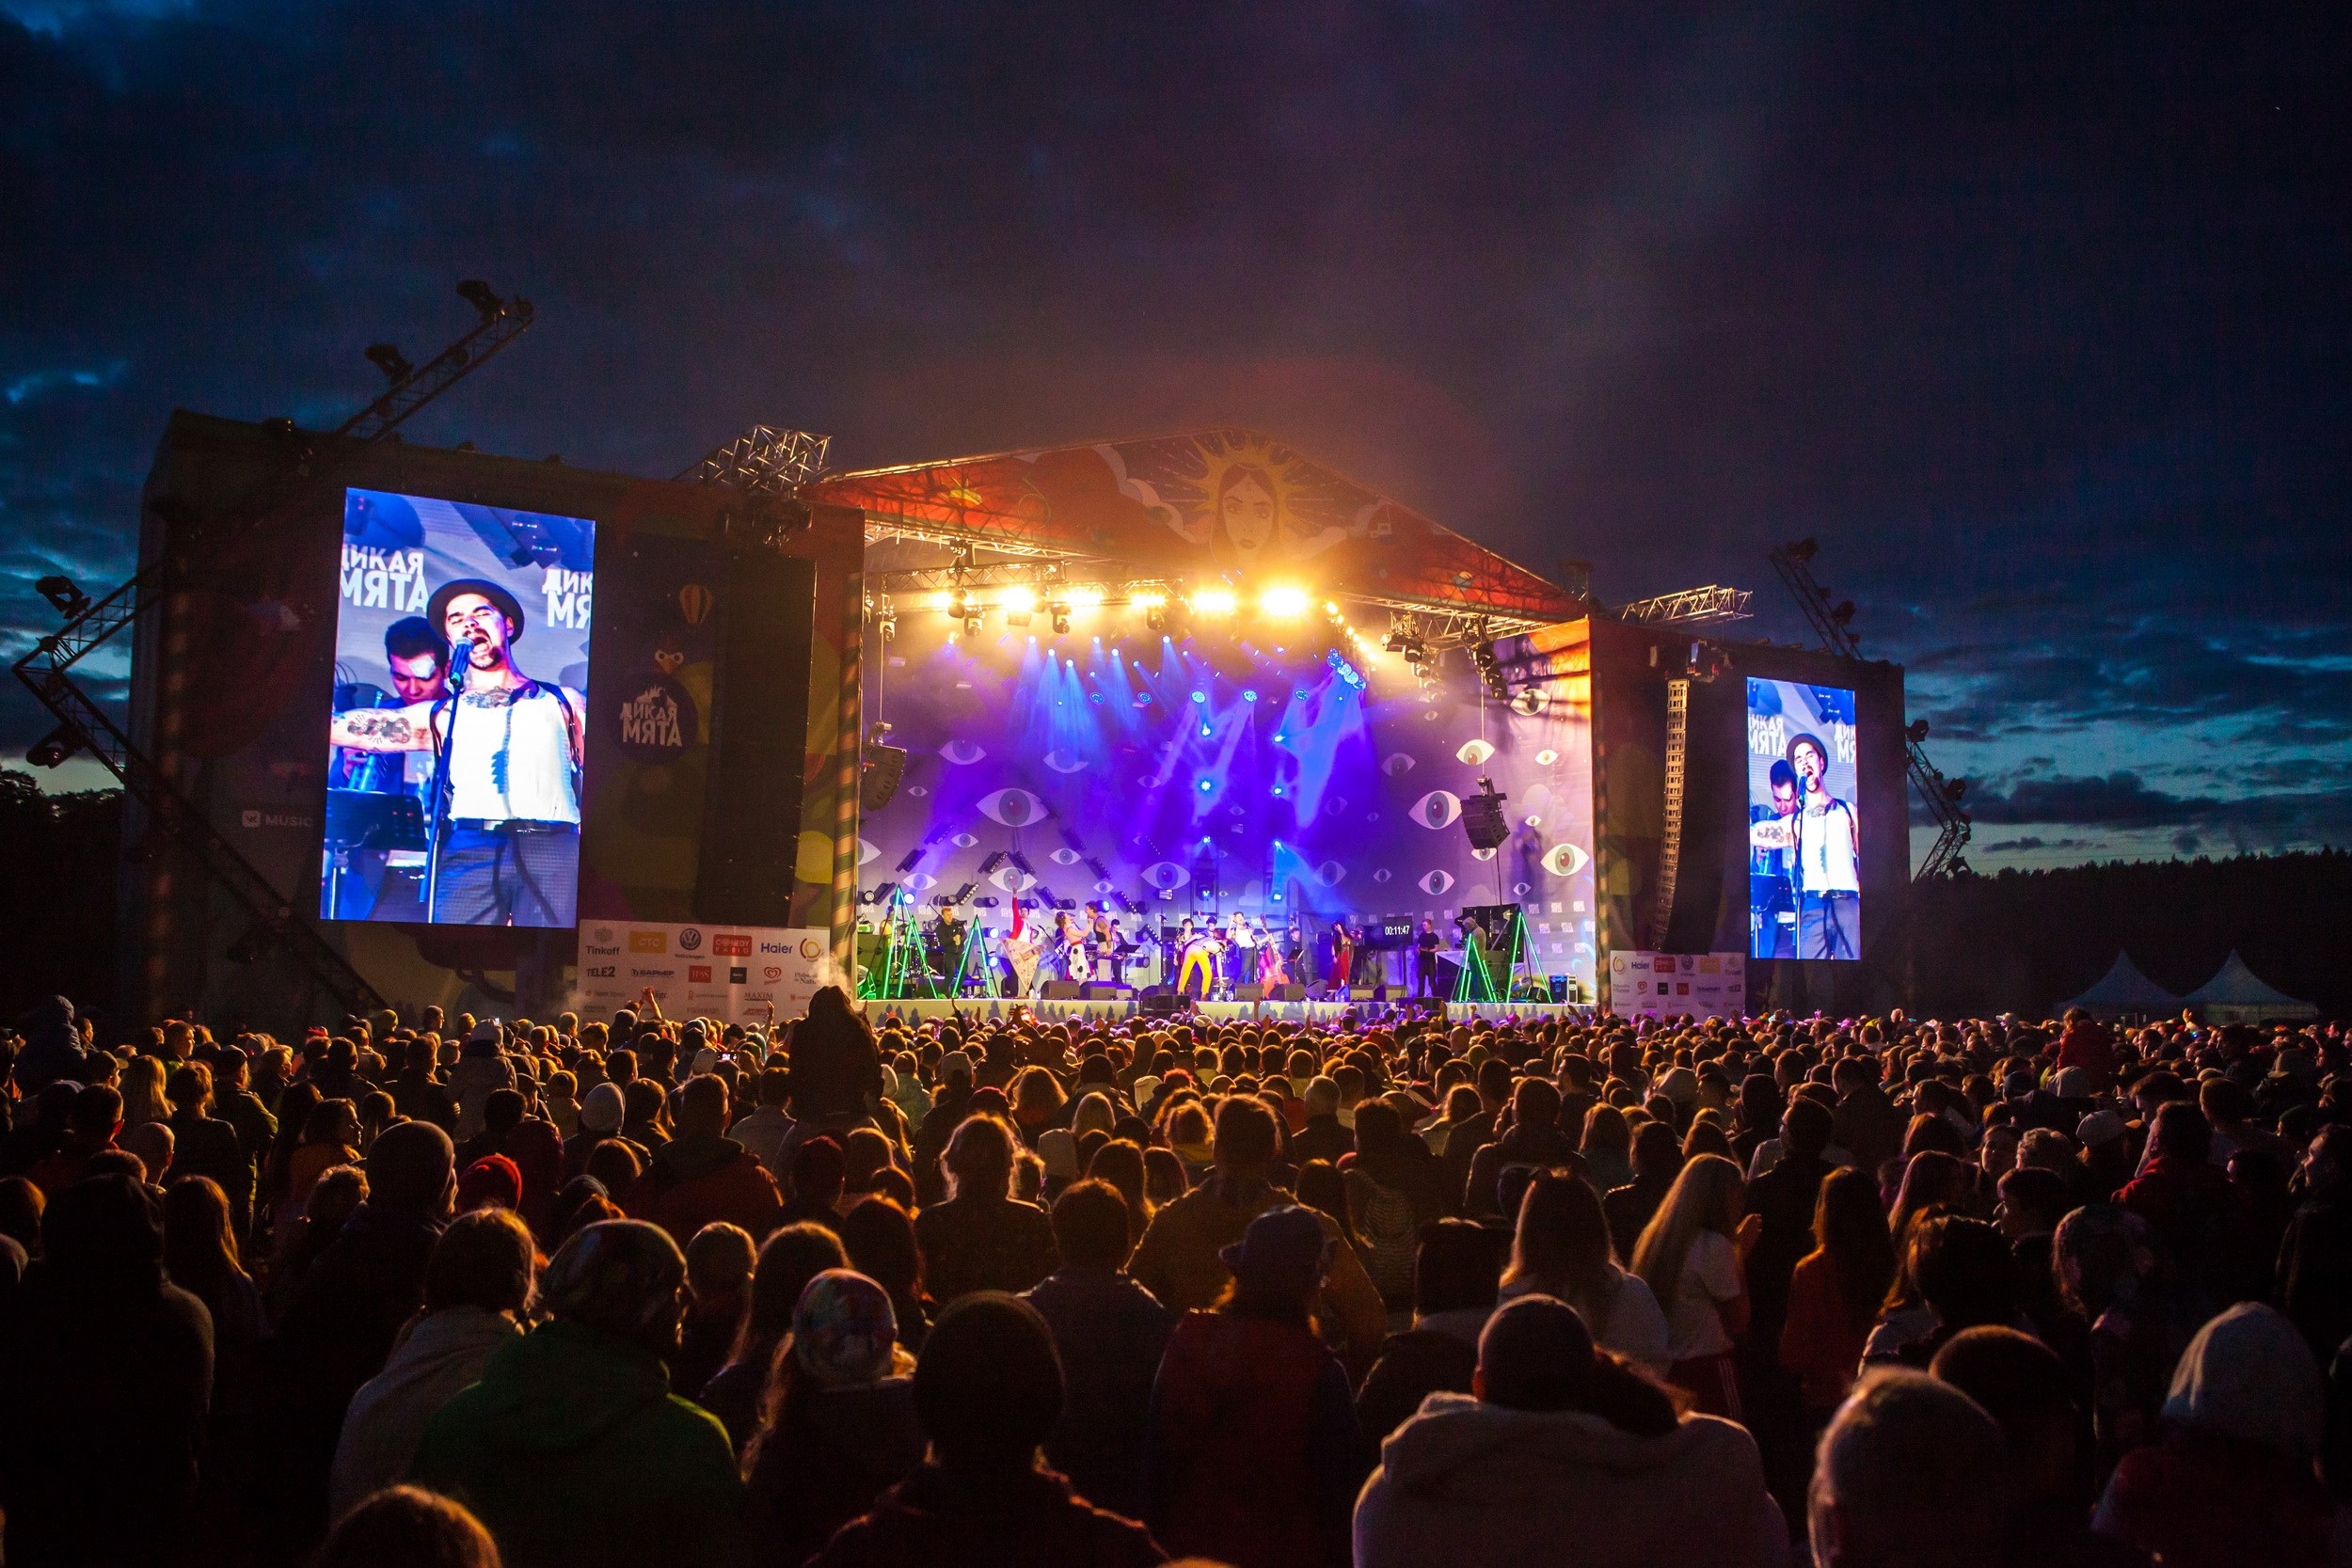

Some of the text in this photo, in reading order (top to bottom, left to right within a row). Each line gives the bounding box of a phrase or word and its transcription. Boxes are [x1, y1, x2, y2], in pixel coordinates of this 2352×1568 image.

[620, 703, 677, 721] ДИКАЯ
[623, 717, 682, 746] МЯТА
[265, 815, 314, 827] MUSIC
[1384, 925, 1410, 936] 00:11:47
[586, 945, 621, 956] Tinkoff
[760, 942, 793, 954] Haier
[1631, 960, 1650, 970] Haier
[586, 966, 615, 977] TELE2
